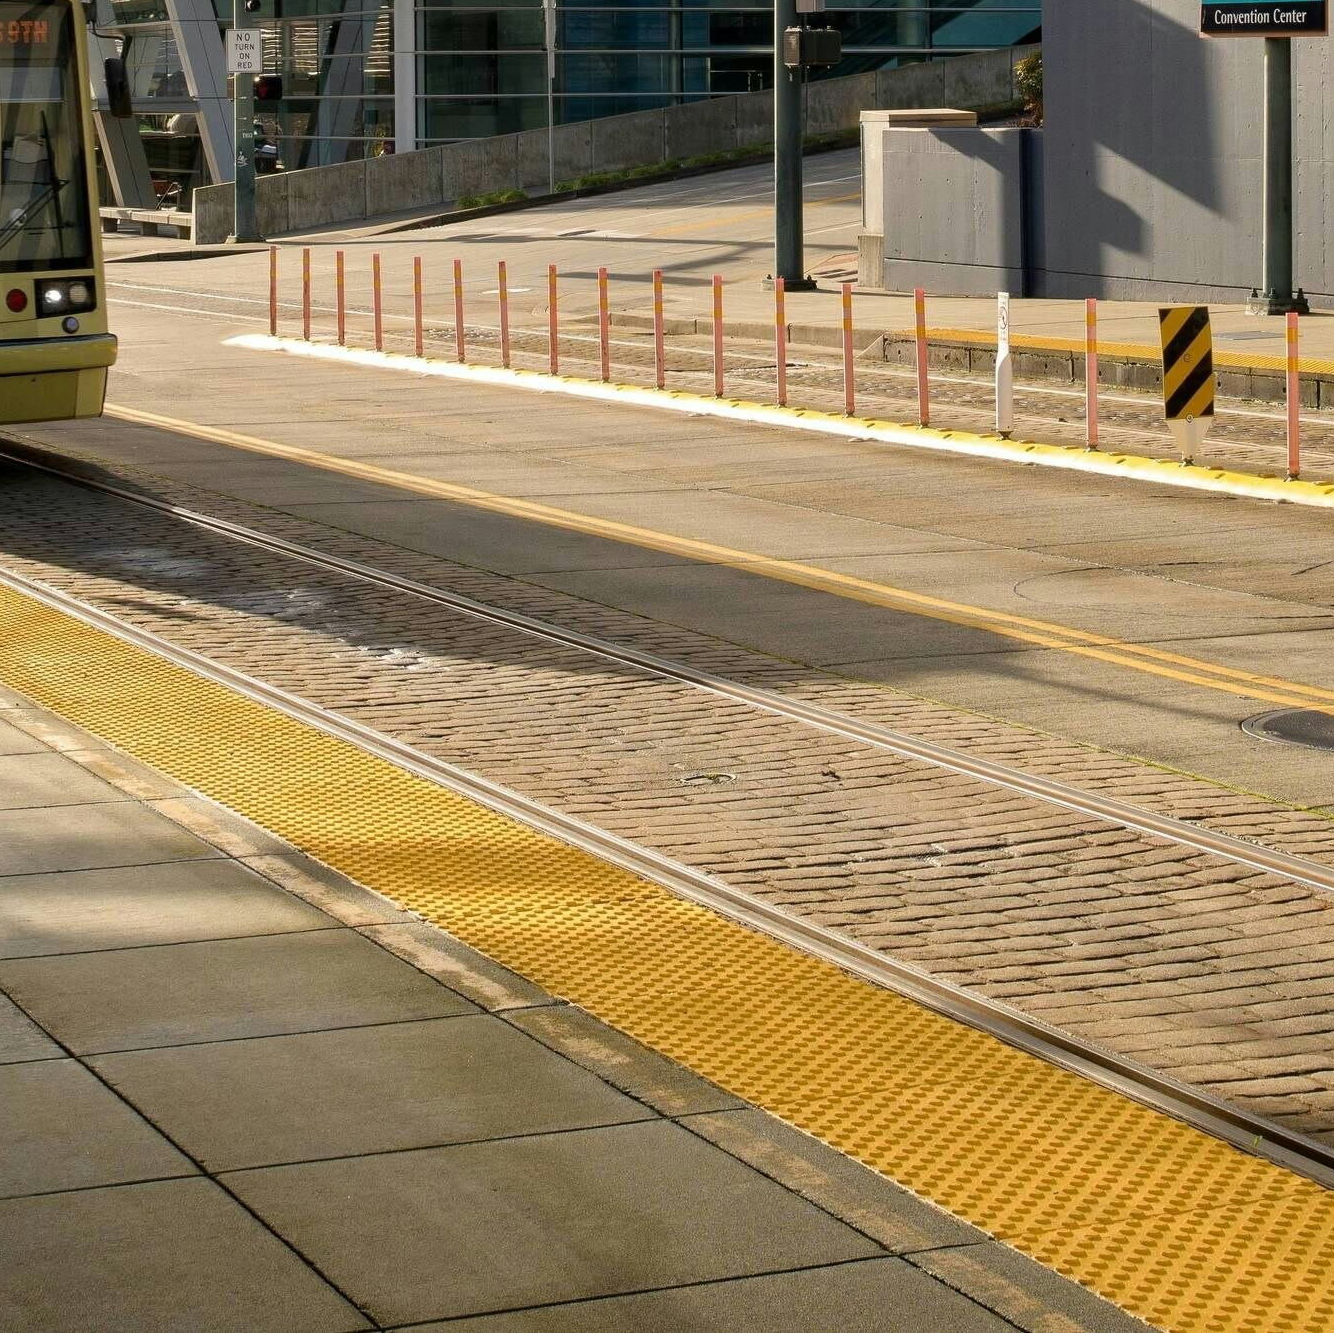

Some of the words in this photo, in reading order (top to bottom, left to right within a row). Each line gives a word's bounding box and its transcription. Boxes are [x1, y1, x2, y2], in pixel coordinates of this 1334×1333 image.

[1214, 9, 1270, 25] Convention
[1273, 8, 1307, 24] Center
[8, 21, 48, 44] 9TH
[236, 33, 251, 42] NO
[235, 43, 255, 51] TURN
[239, 52, 250, 60] ON
[237, 61, 253, 69] RED
